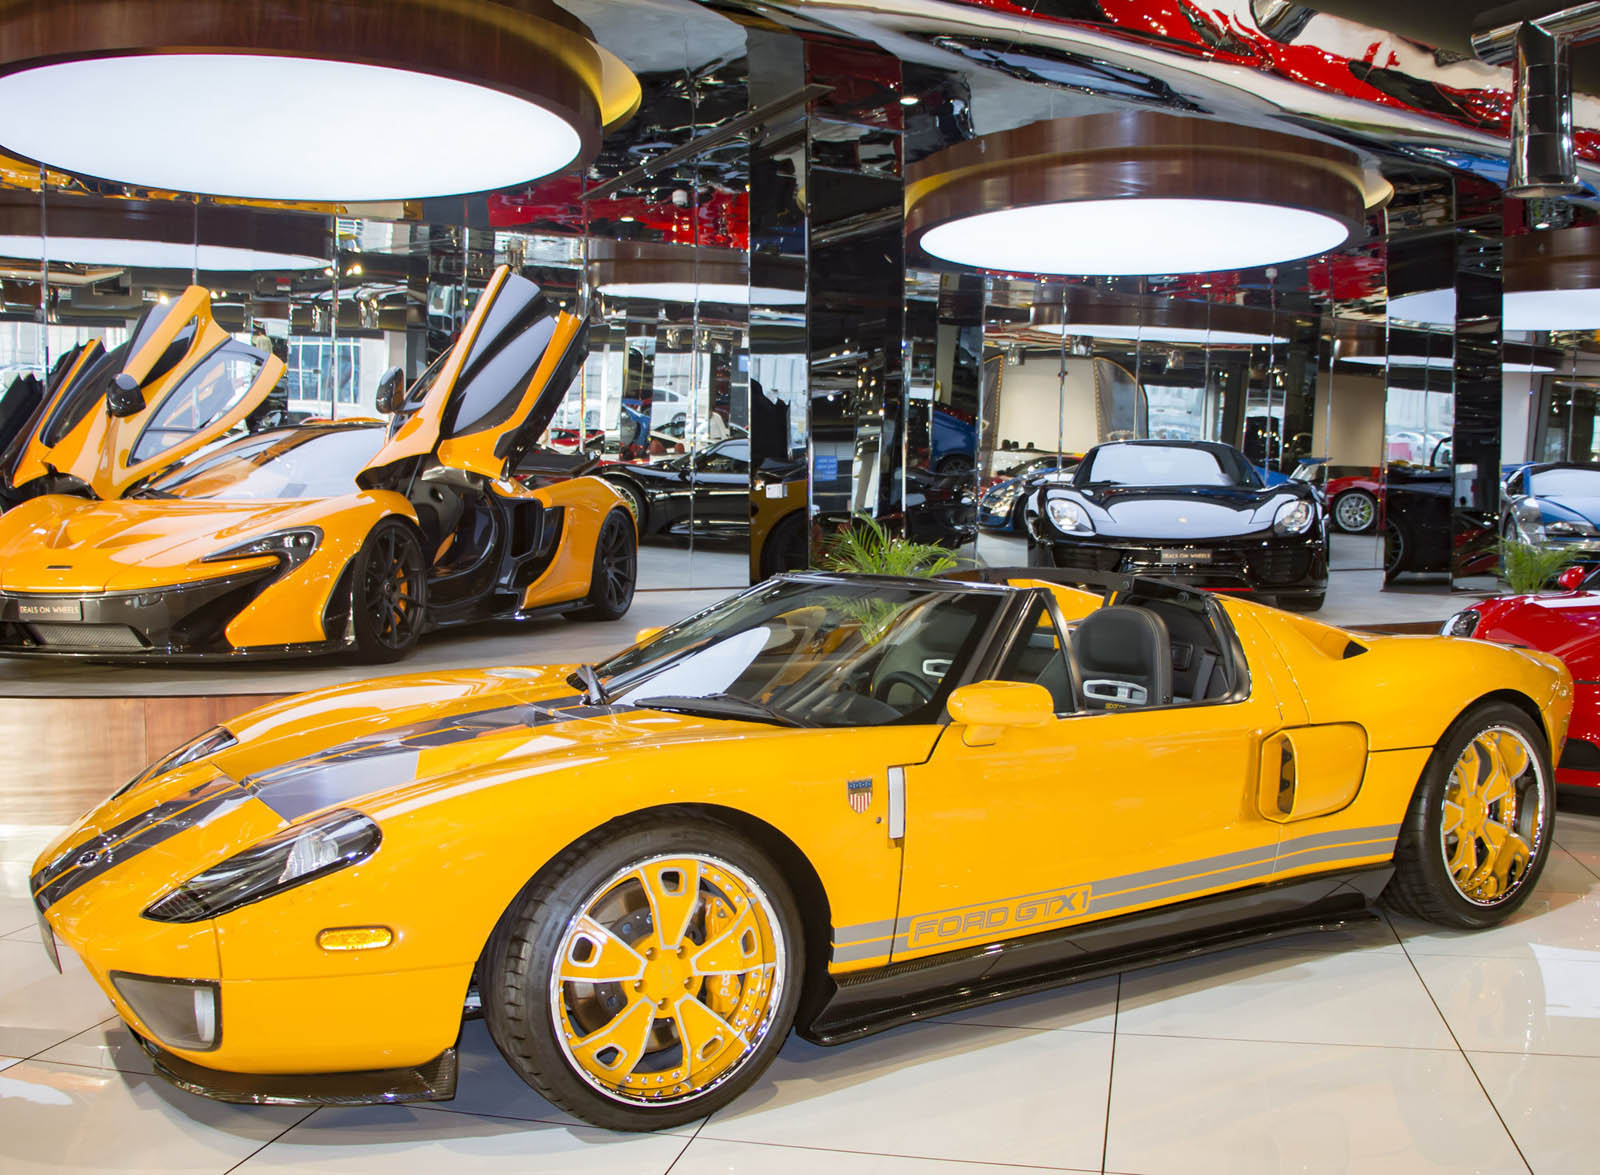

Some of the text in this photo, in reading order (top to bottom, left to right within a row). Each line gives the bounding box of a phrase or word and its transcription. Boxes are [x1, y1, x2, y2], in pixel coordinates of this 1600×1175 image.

[20, 606, 79, 614] DEALS ON WHEELS
[914, 906, 1009, 942] FORD
